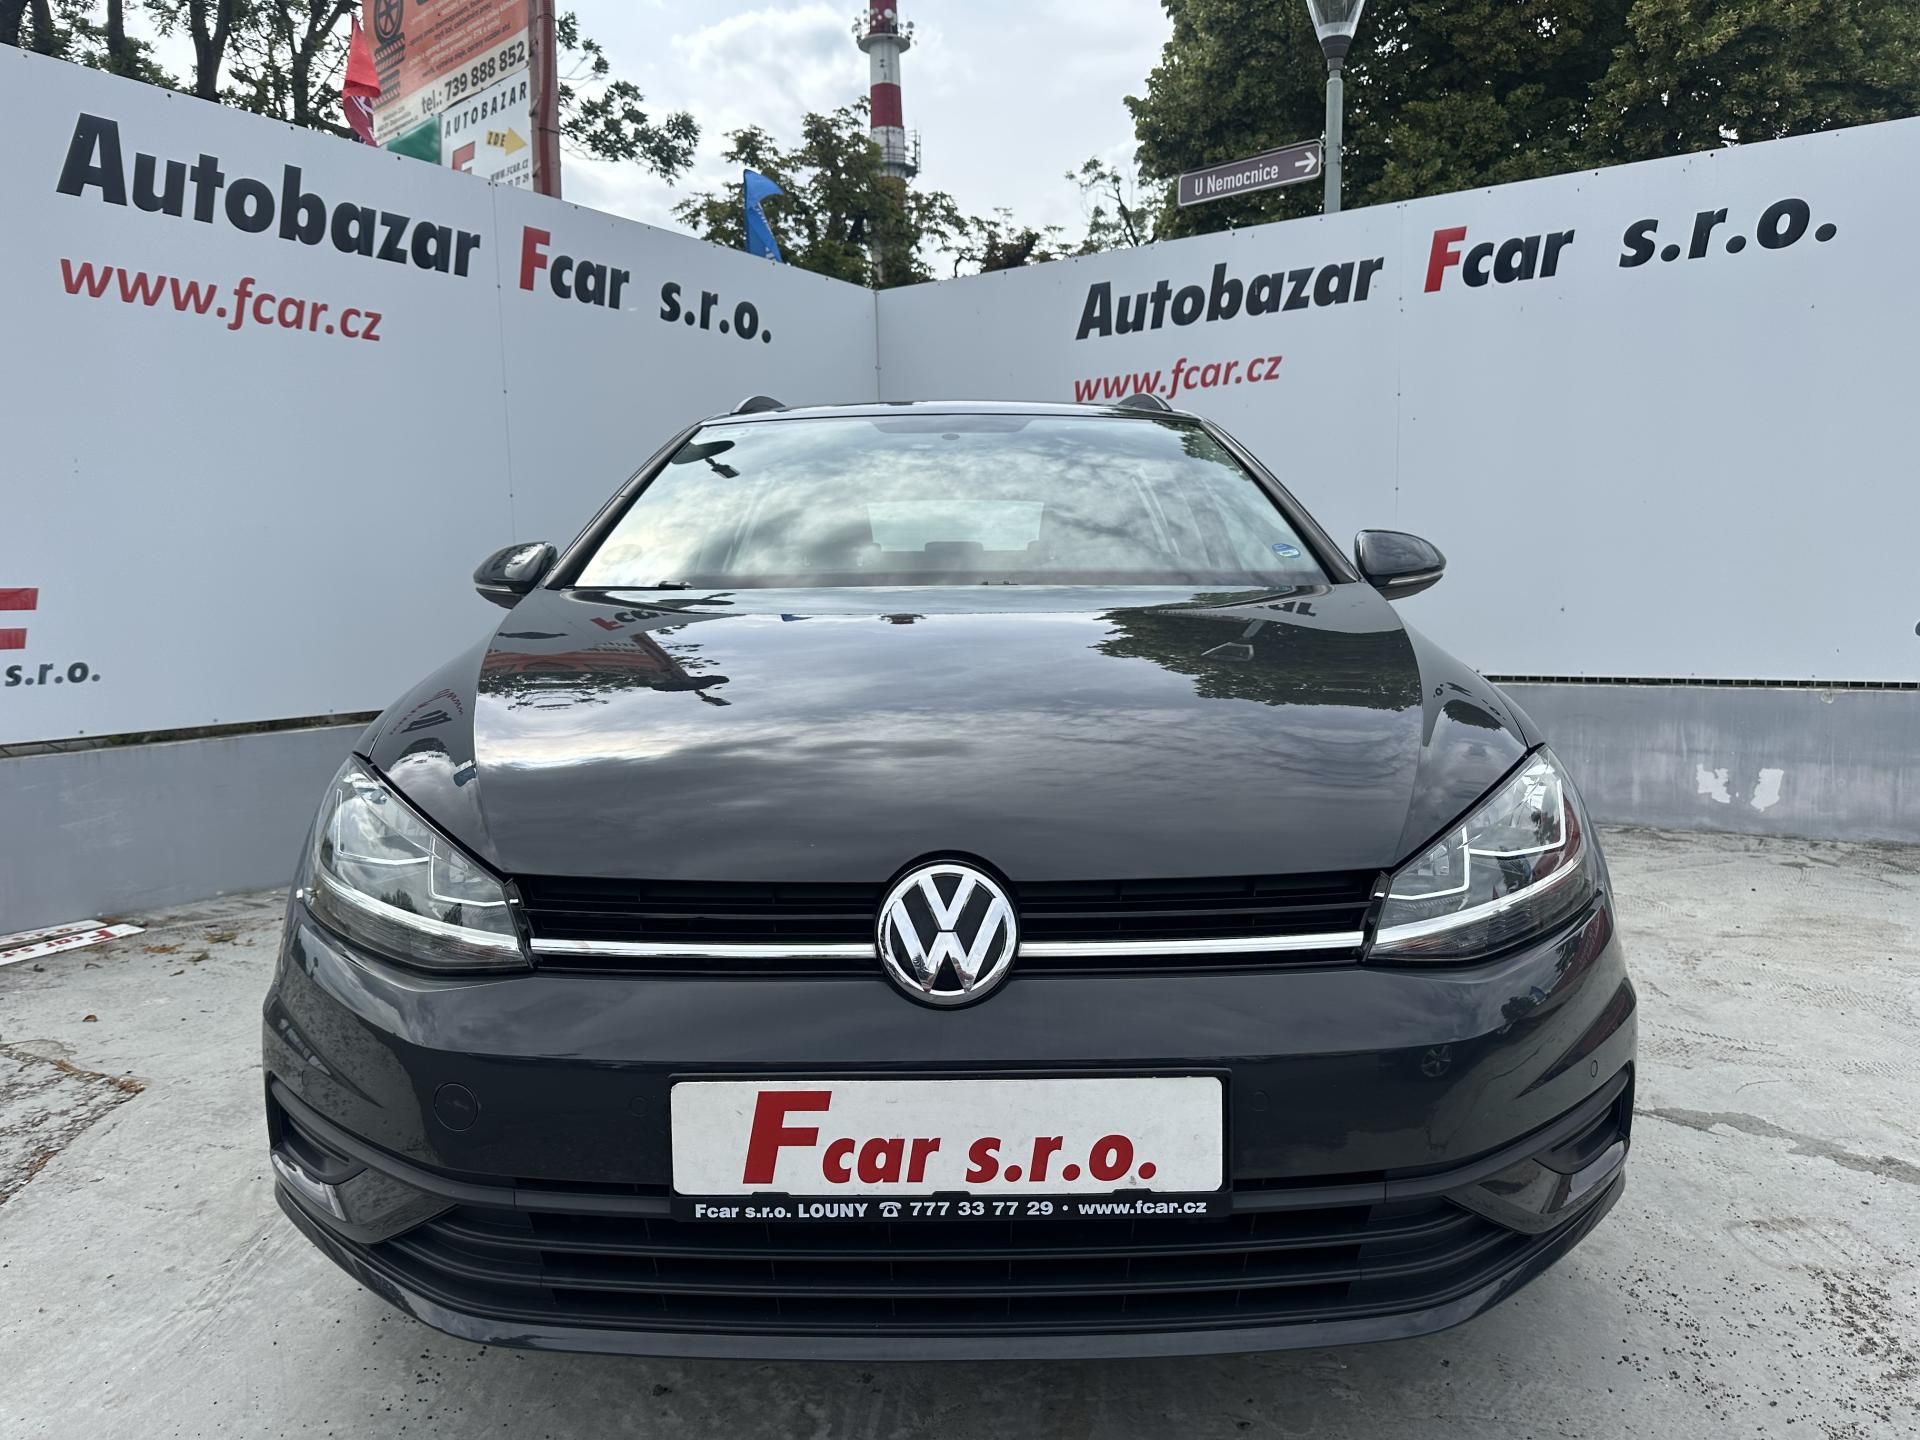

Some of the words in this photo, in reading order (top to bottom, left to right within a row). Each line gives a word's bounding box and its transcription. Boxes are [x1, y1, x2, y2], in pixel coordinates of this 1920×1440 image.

[422, 90, 442, 114] tel.:
[445, 73, 467, 101] 739
[471, 57, 495, 87] 888
[499, 41, 525, 69] 852
[444, 81, 527, 139] AUTOBAZAR
[1194, 178, 1203, 196] U
[1207, 164, 1279, 193] Nemocnice
[56, 113, 480, 277] Autobazar
[520, 226, 629, 309] Fcar
[661, 282, 772, 343] s.r.o.
[60, 259, 382, 342] www.fcar.cz
[1077, 261, 1384, 340] Autobazar
[1424, 226, 1575, 293] Fcar
[1619, 198, 1837, 268] s.r.o.
[1074, 355, 1283, 402] www.fcar.cz
[4, 662, 101, 687] s.r.o.
[743, 1090, 941, 1185] Fcar
[965, 1135, 1157, 1183] s.r.o.
[695, 1203, 740, 1218] Fcar
[744, 1204, 792, 1218] s.r.o.
[798, 1203, 868, 1218] LOUNY
[910, 1202, 950, 1216] 777
[957, 1201, 985, 1216] 33
[992, 1202, 1019, 1216] 77
[1026, 1201, 1054, 1216] 29
[1078, 1200, 1207, 1215] www.fcar.cz
